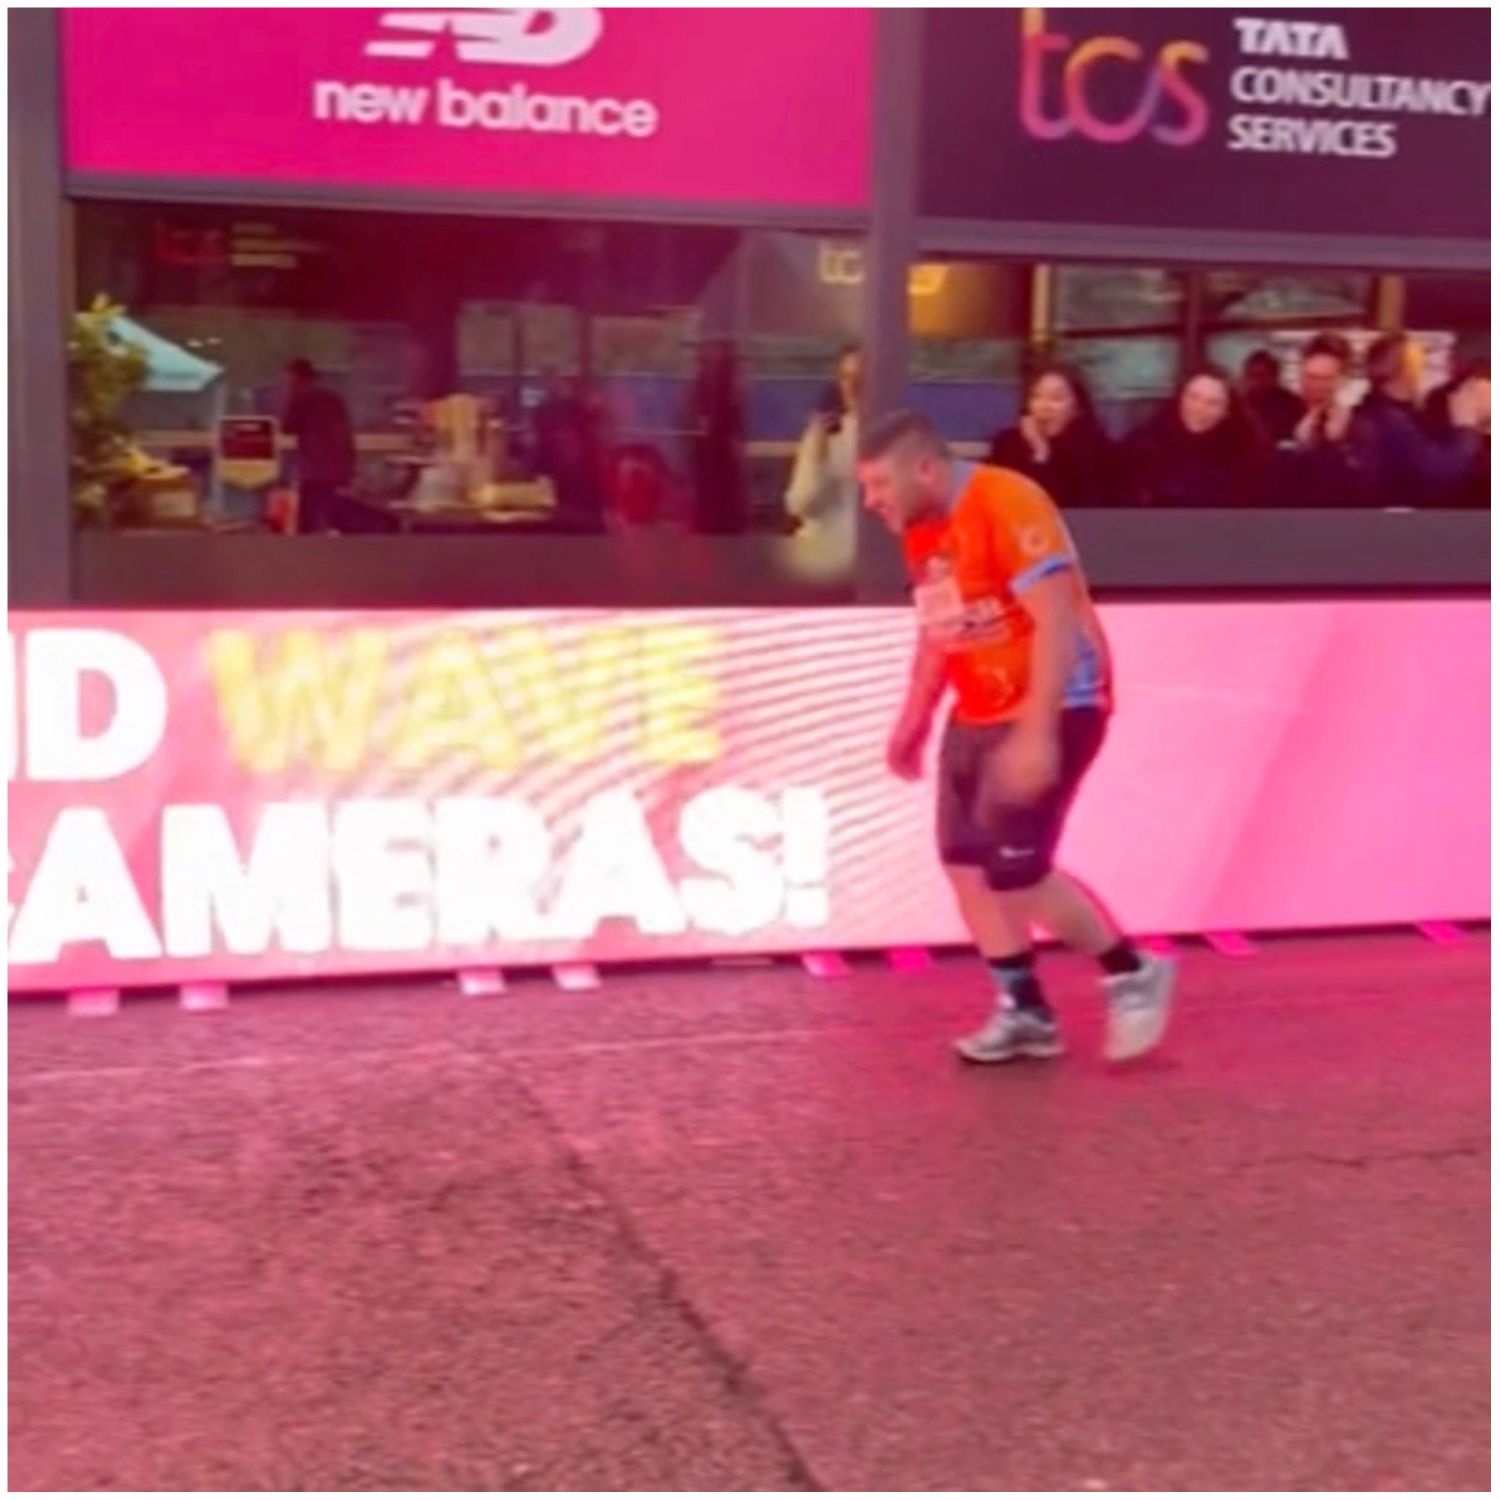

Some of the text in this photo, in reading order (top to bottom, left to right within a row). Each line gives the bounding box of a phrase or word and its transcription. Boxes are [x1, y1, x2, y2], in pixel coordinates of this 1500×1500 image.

[1233, 17, 1350, 60] TATA
[312, 76, 659, 138] new balance
[1018, 8, 1209, 145] tcs
[1229, 66, 1491, 116] CONSULTANCY
[1226, 114, 1398, 158] SERVICES
[208, 622, 726, 776] WAVE
[7, 786, 830, 963] AMERAS!
